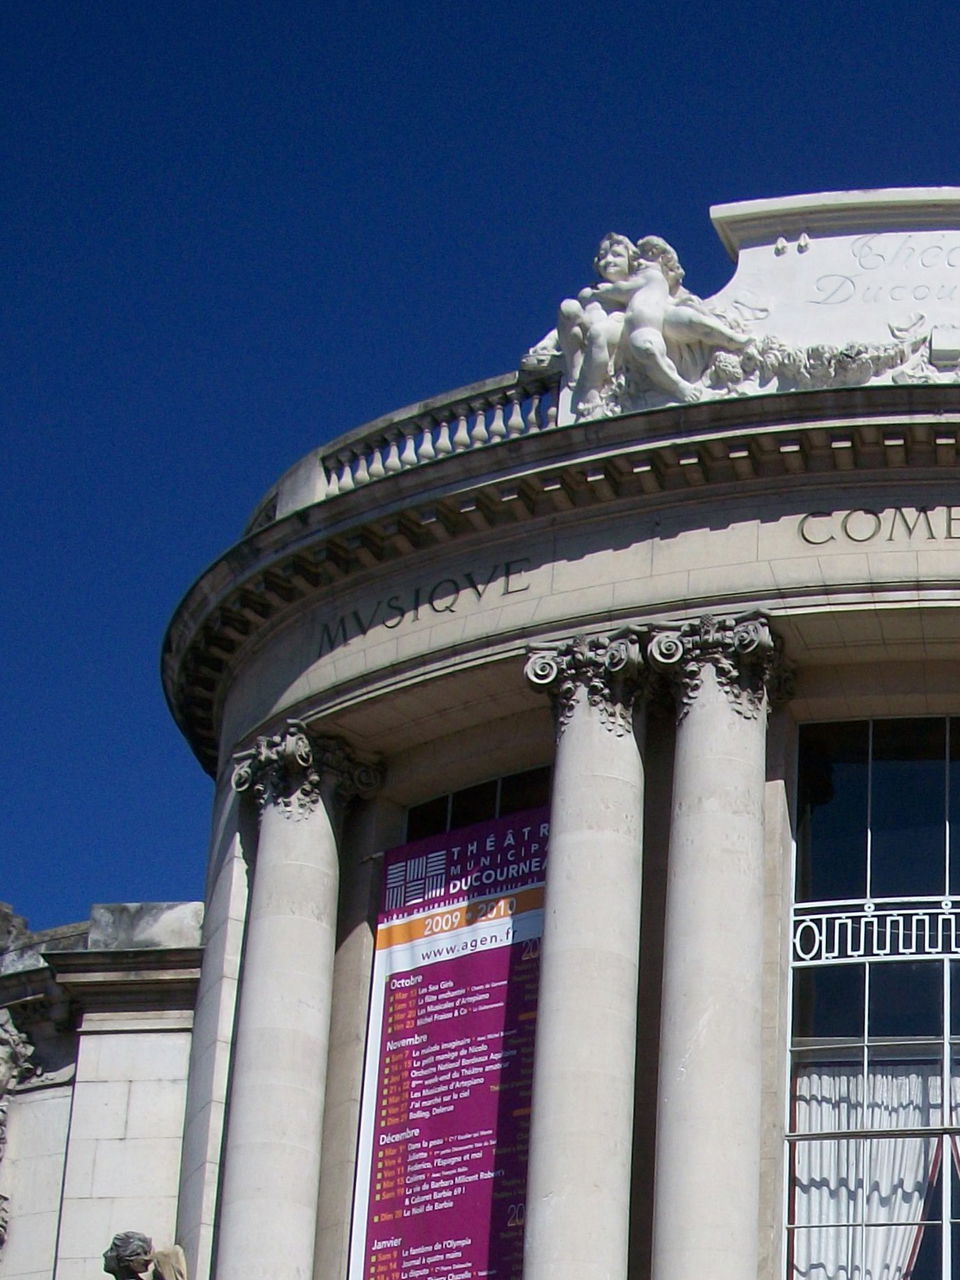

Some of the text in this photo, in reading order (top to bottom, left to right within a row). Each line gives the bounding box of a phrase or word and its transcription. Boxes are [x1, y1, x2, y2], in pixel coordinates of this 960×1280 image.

[317, 557, 532, 658] MVSIQVE
[424, 897, 517, 936] 2009 2010
[420, 926, 517, 961] www.agen.fr
[390, 973, 422, 990] Octobre
[386, 1032, 427, 1051] Novembre
[379, 1125, 419, 1145] Décembre
[371, 1234, 402, 1251] Janvier
